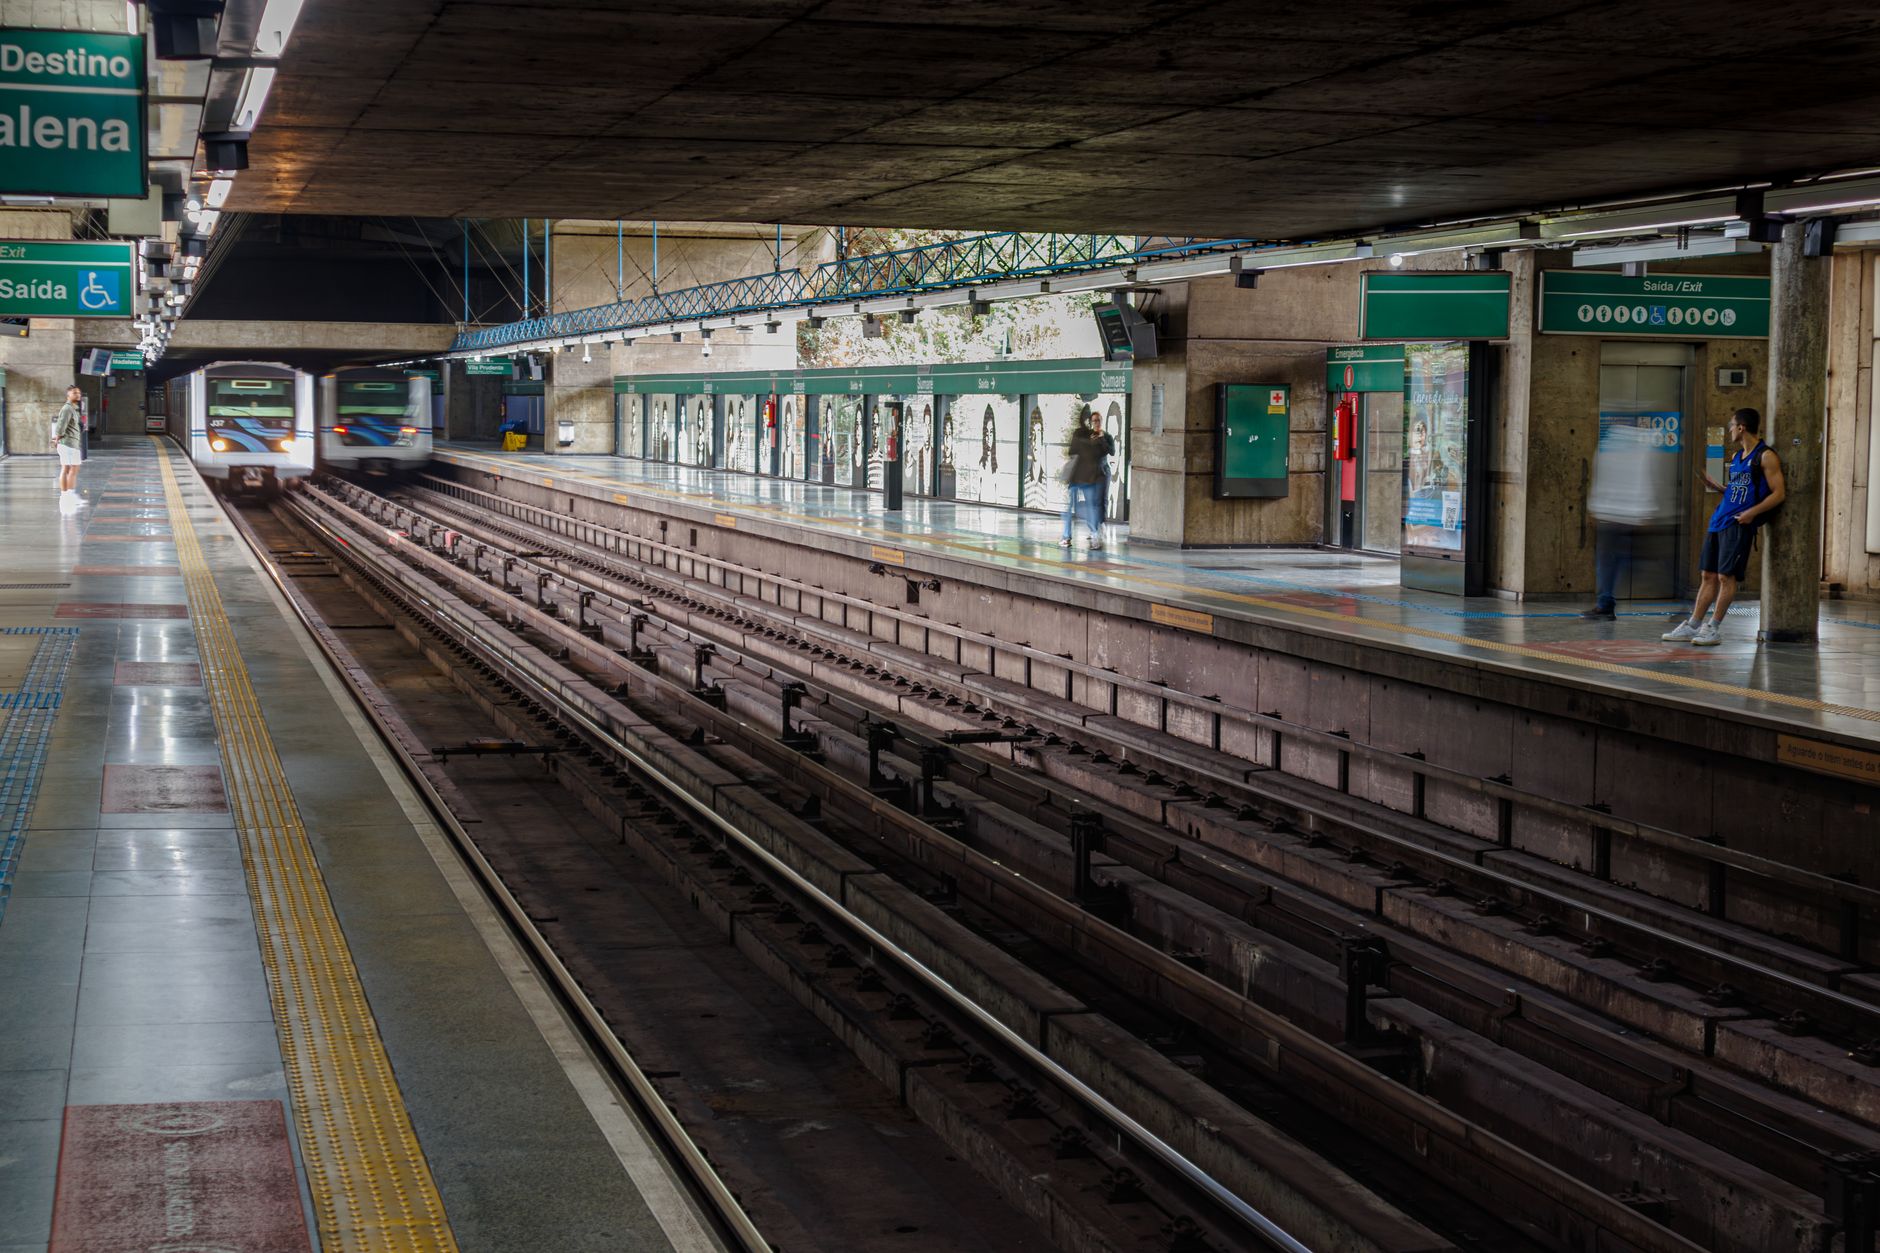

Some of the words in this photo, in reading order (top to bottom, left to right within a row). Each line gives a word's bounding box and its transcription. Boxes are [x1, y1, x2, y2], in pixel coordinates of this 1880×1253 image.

[1, 44, 131, 78] Destino
[0, 246, 26, 258] Exit
[0, 279, 67, 299] Saída
[1643, 280, 1673, 292] Saída
[917, 377, 934, 390] Sumaré
[1101, 371, 1126, 388] Sumaré
[1787, 743, 1816, 759] Aguarde
[1818, 752, 1824, 760] o
